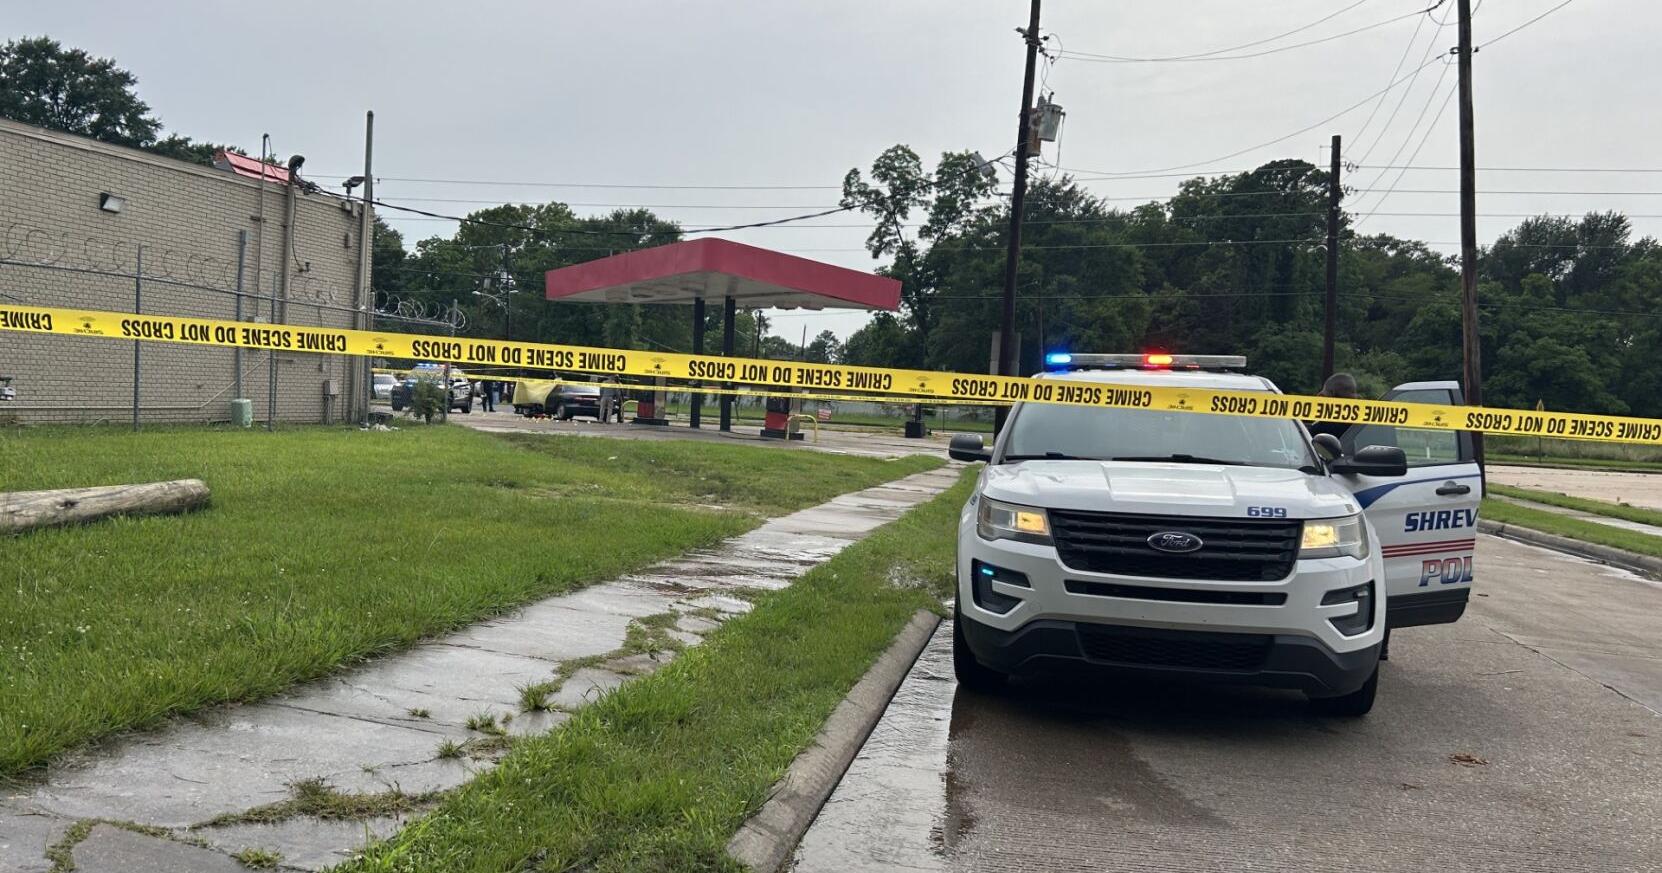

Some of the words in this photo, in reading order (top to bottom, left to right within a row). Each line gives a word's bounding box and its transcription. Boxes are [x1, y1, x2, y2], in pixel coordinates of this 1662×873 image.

[0, 310, 53, 331] CRIME
[121, 319, 174, 340] CROSS
[180, 323, 210, 342] NOT
[214, 326, 237, 344] DO
[242, 328, 291, 348] SCENE
[296, 332, 347, 352] CRIME
[412, 340, 462, 360] CROSS
[467, 344, 496, 362] NOT
[501, 346, 522, 365] DO
[526, 348, 574, 368] SCENE
[578, 352, 626, 372] CRIME
[688, 360, 736, 380] CROSS
[739, 364, 768, 382] NOT
[772, 366, 792, 384] DO
[796, 368, 842, 387] SCENE
[846, 371, 892, 390] CRIME
[951, 378, 998, 398] CROSS
[1001, 382, 1030, 399] NOT
[1033, 384, 1053, 401] DO
[1056, 385, 1102, 405] SCENE
[1105, 388, 1152, 407] CRIME
[1210, 395, 1257, 415] CROSS
[1259, 399, 1289, 416] NOT
[1292, 401, 1312, 418] DO
[1314, 402, 1360, 421] SCENE
[1362, 405, 1409, 424] CRIME
[1465, 412, 1512, 431] CROSS
[1514, 415, 1544, 433] NOT
[1546, 417, 1566, 434] DO
[1569, 419, 1614, 438] SCENE
[1616, 422, 1662, 441] CRIME
[1247, 506, 1287, 518] 699
[1404, 508, 1479, 533] SHREV
[1160, 533, 1190, 548] Ford
